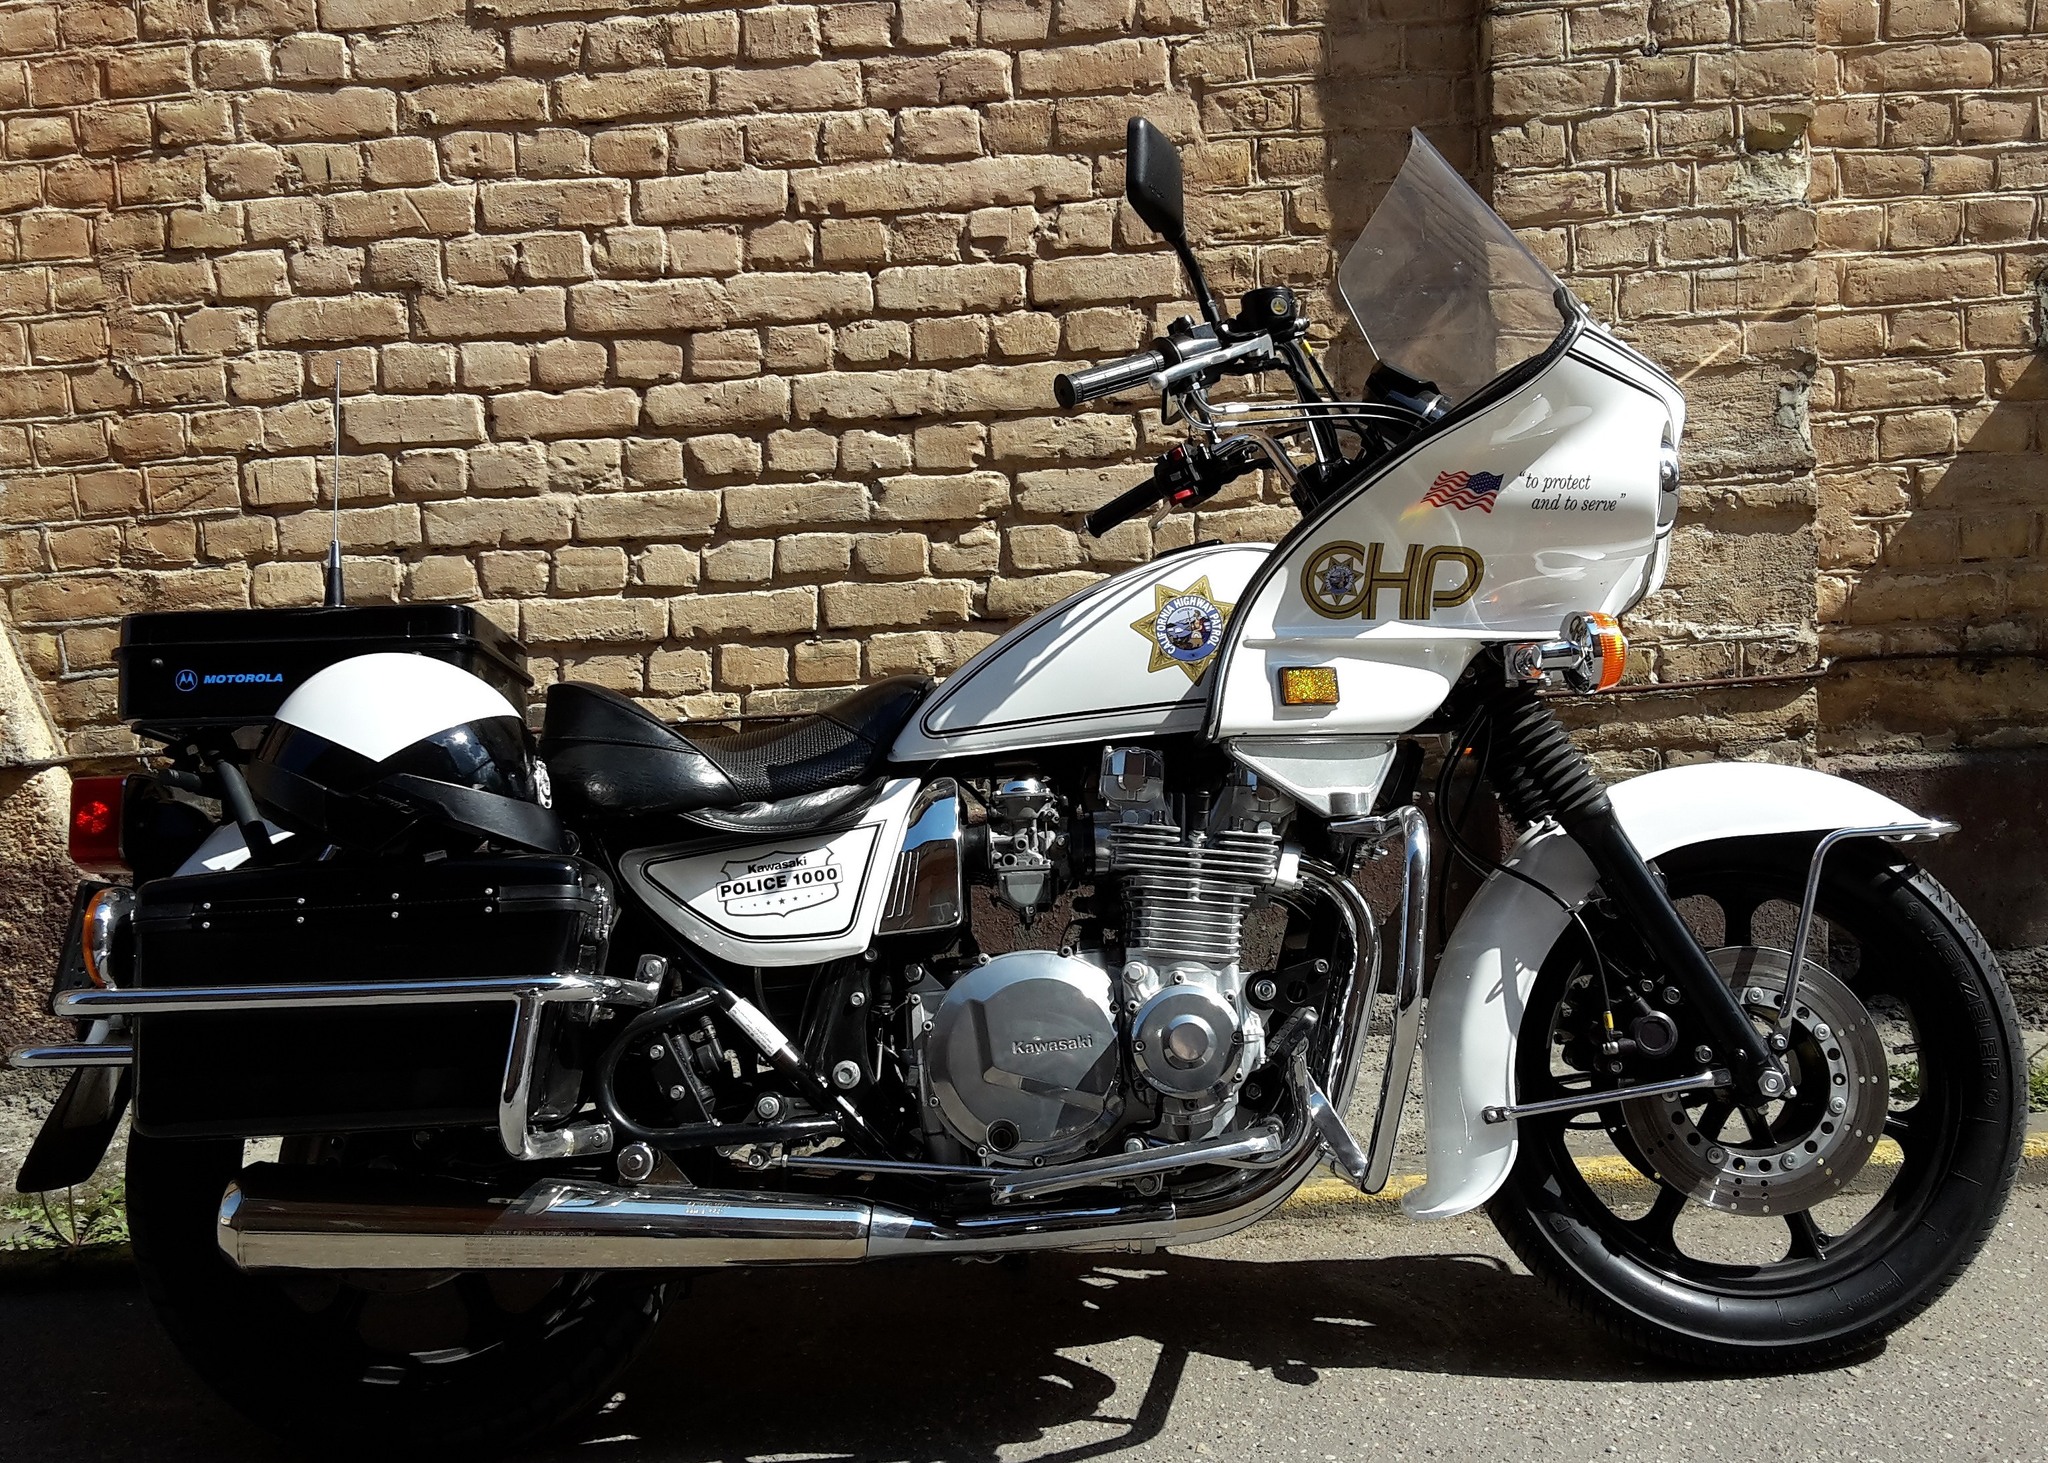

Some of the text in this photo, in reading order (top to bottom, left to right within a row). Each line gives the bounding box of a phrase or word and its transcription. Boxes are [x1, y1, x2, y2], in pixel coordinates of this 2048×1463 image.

[1541, 474, 1591, 492] protect
[1531, 493, 1561, 510] and
[1564, 495, 1578, 510] to
[1300, 540, 1485, 620] CHP
[1156, 596, 1222, 654] CALIFORNIA HIGHWAY PATROL
[203, 673, 283, 684] MOTOROLA
[747, 856, 807, 874] Kawasaki
[720, 867, 838, 898] POLICE 1000
[1012, 1034, 1093, 1055] Kawasaki
